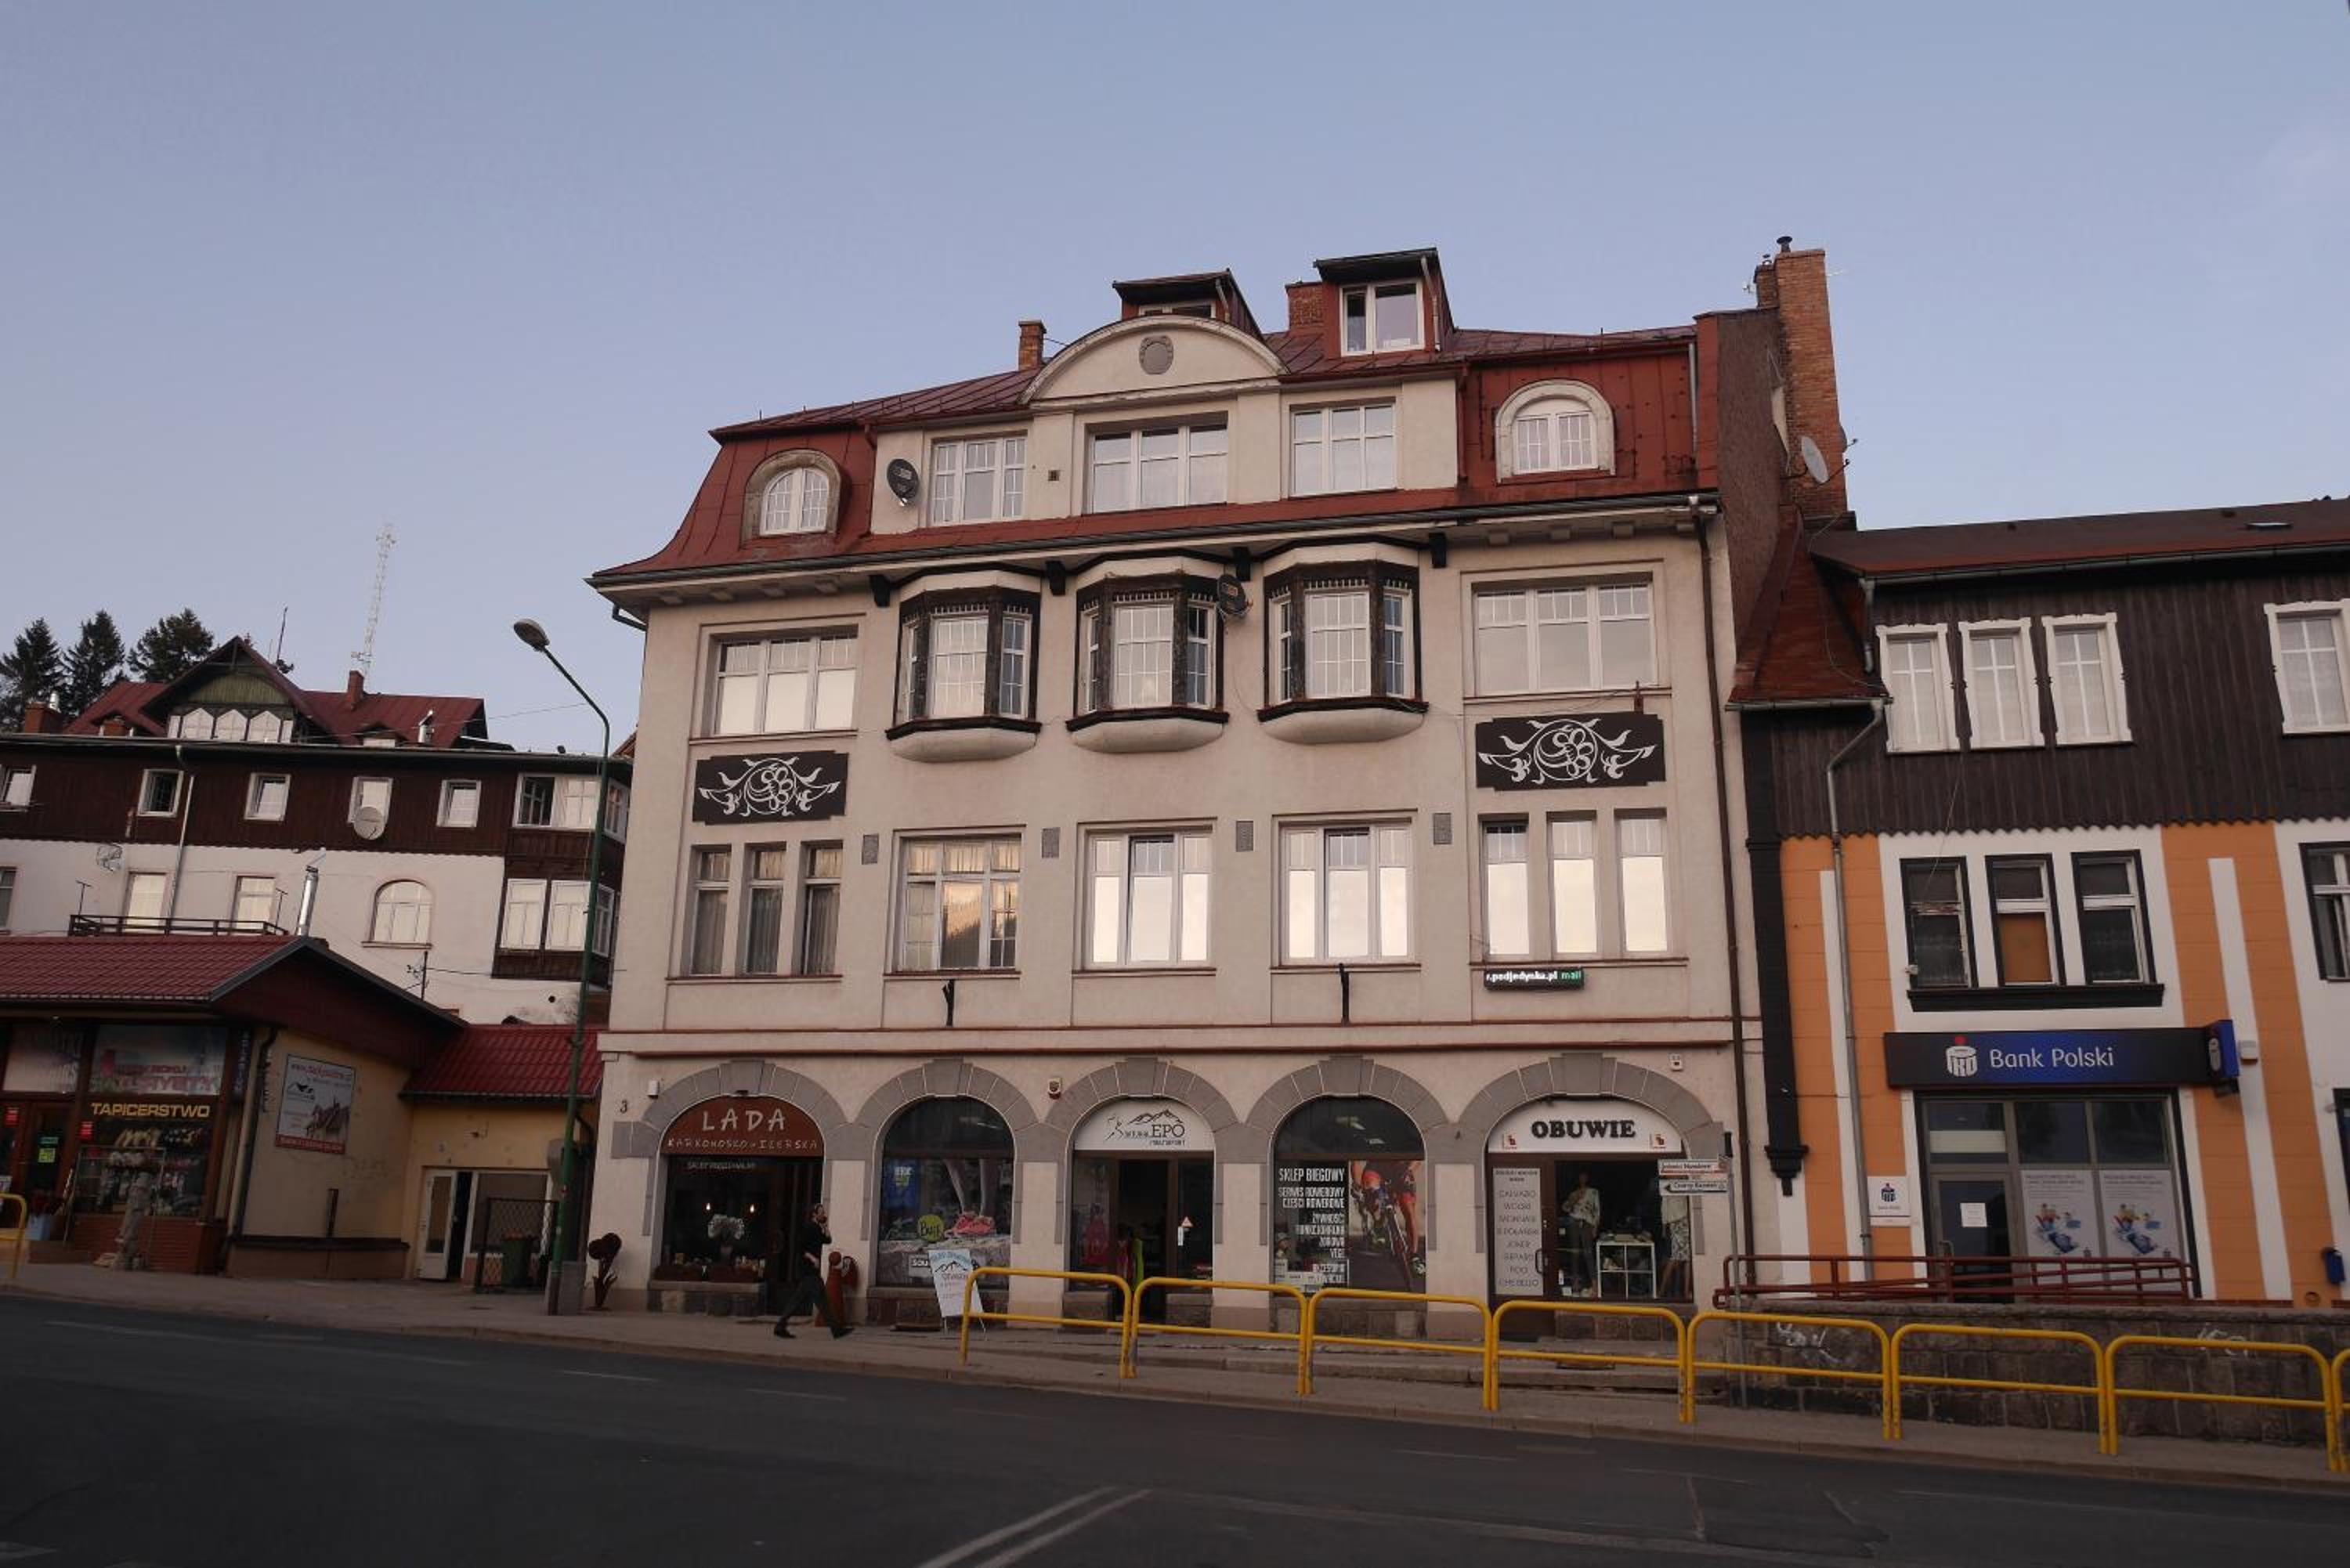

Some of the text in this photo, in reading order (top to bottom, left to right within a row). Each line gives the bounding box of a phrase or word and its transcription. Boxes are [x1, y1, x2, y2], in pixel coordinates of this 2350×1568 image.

[1990, 1046, 2113, 1068] Bank Polski
[90, 1102, 211, 1118] TAPICERSTWO
[702, 1107, 786, 1132] LADA
[1531, 1120, 1636, 1139] OBUWIE
[1278, 1168, 1345, 1182] SKLEP BIEGOWY
